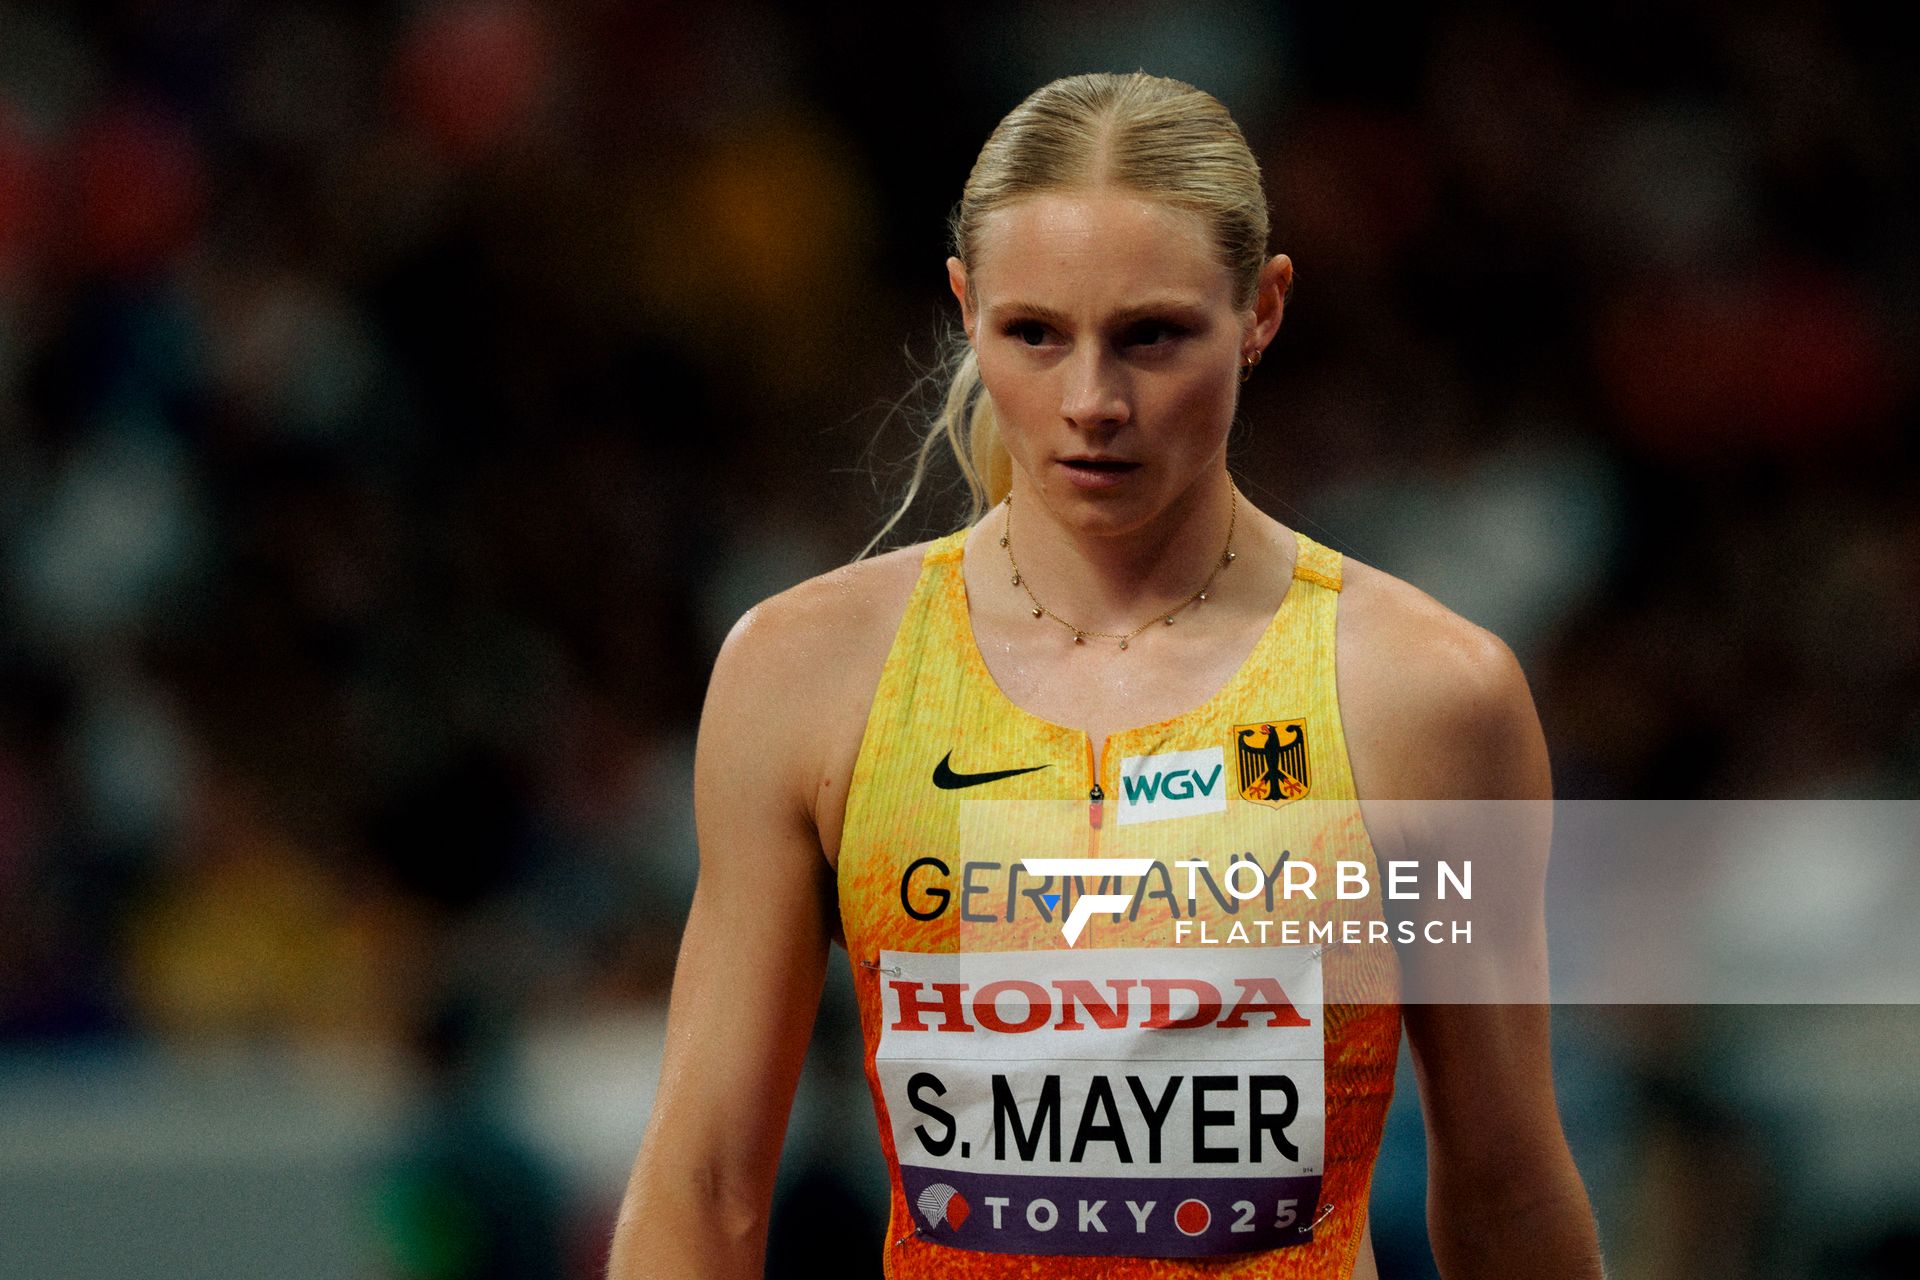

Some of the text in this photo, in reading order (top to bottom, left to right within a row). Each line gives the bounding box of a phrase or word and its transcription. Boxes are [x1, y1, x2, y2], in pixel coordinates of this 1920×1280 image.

[1122, 764, 1223, 806] WGV
[888, 977, 1311, 1034] HONDA
[906, 1072, 1299, 1164] S. MAYER
[1230, 1198, 1299, 1233] 25
